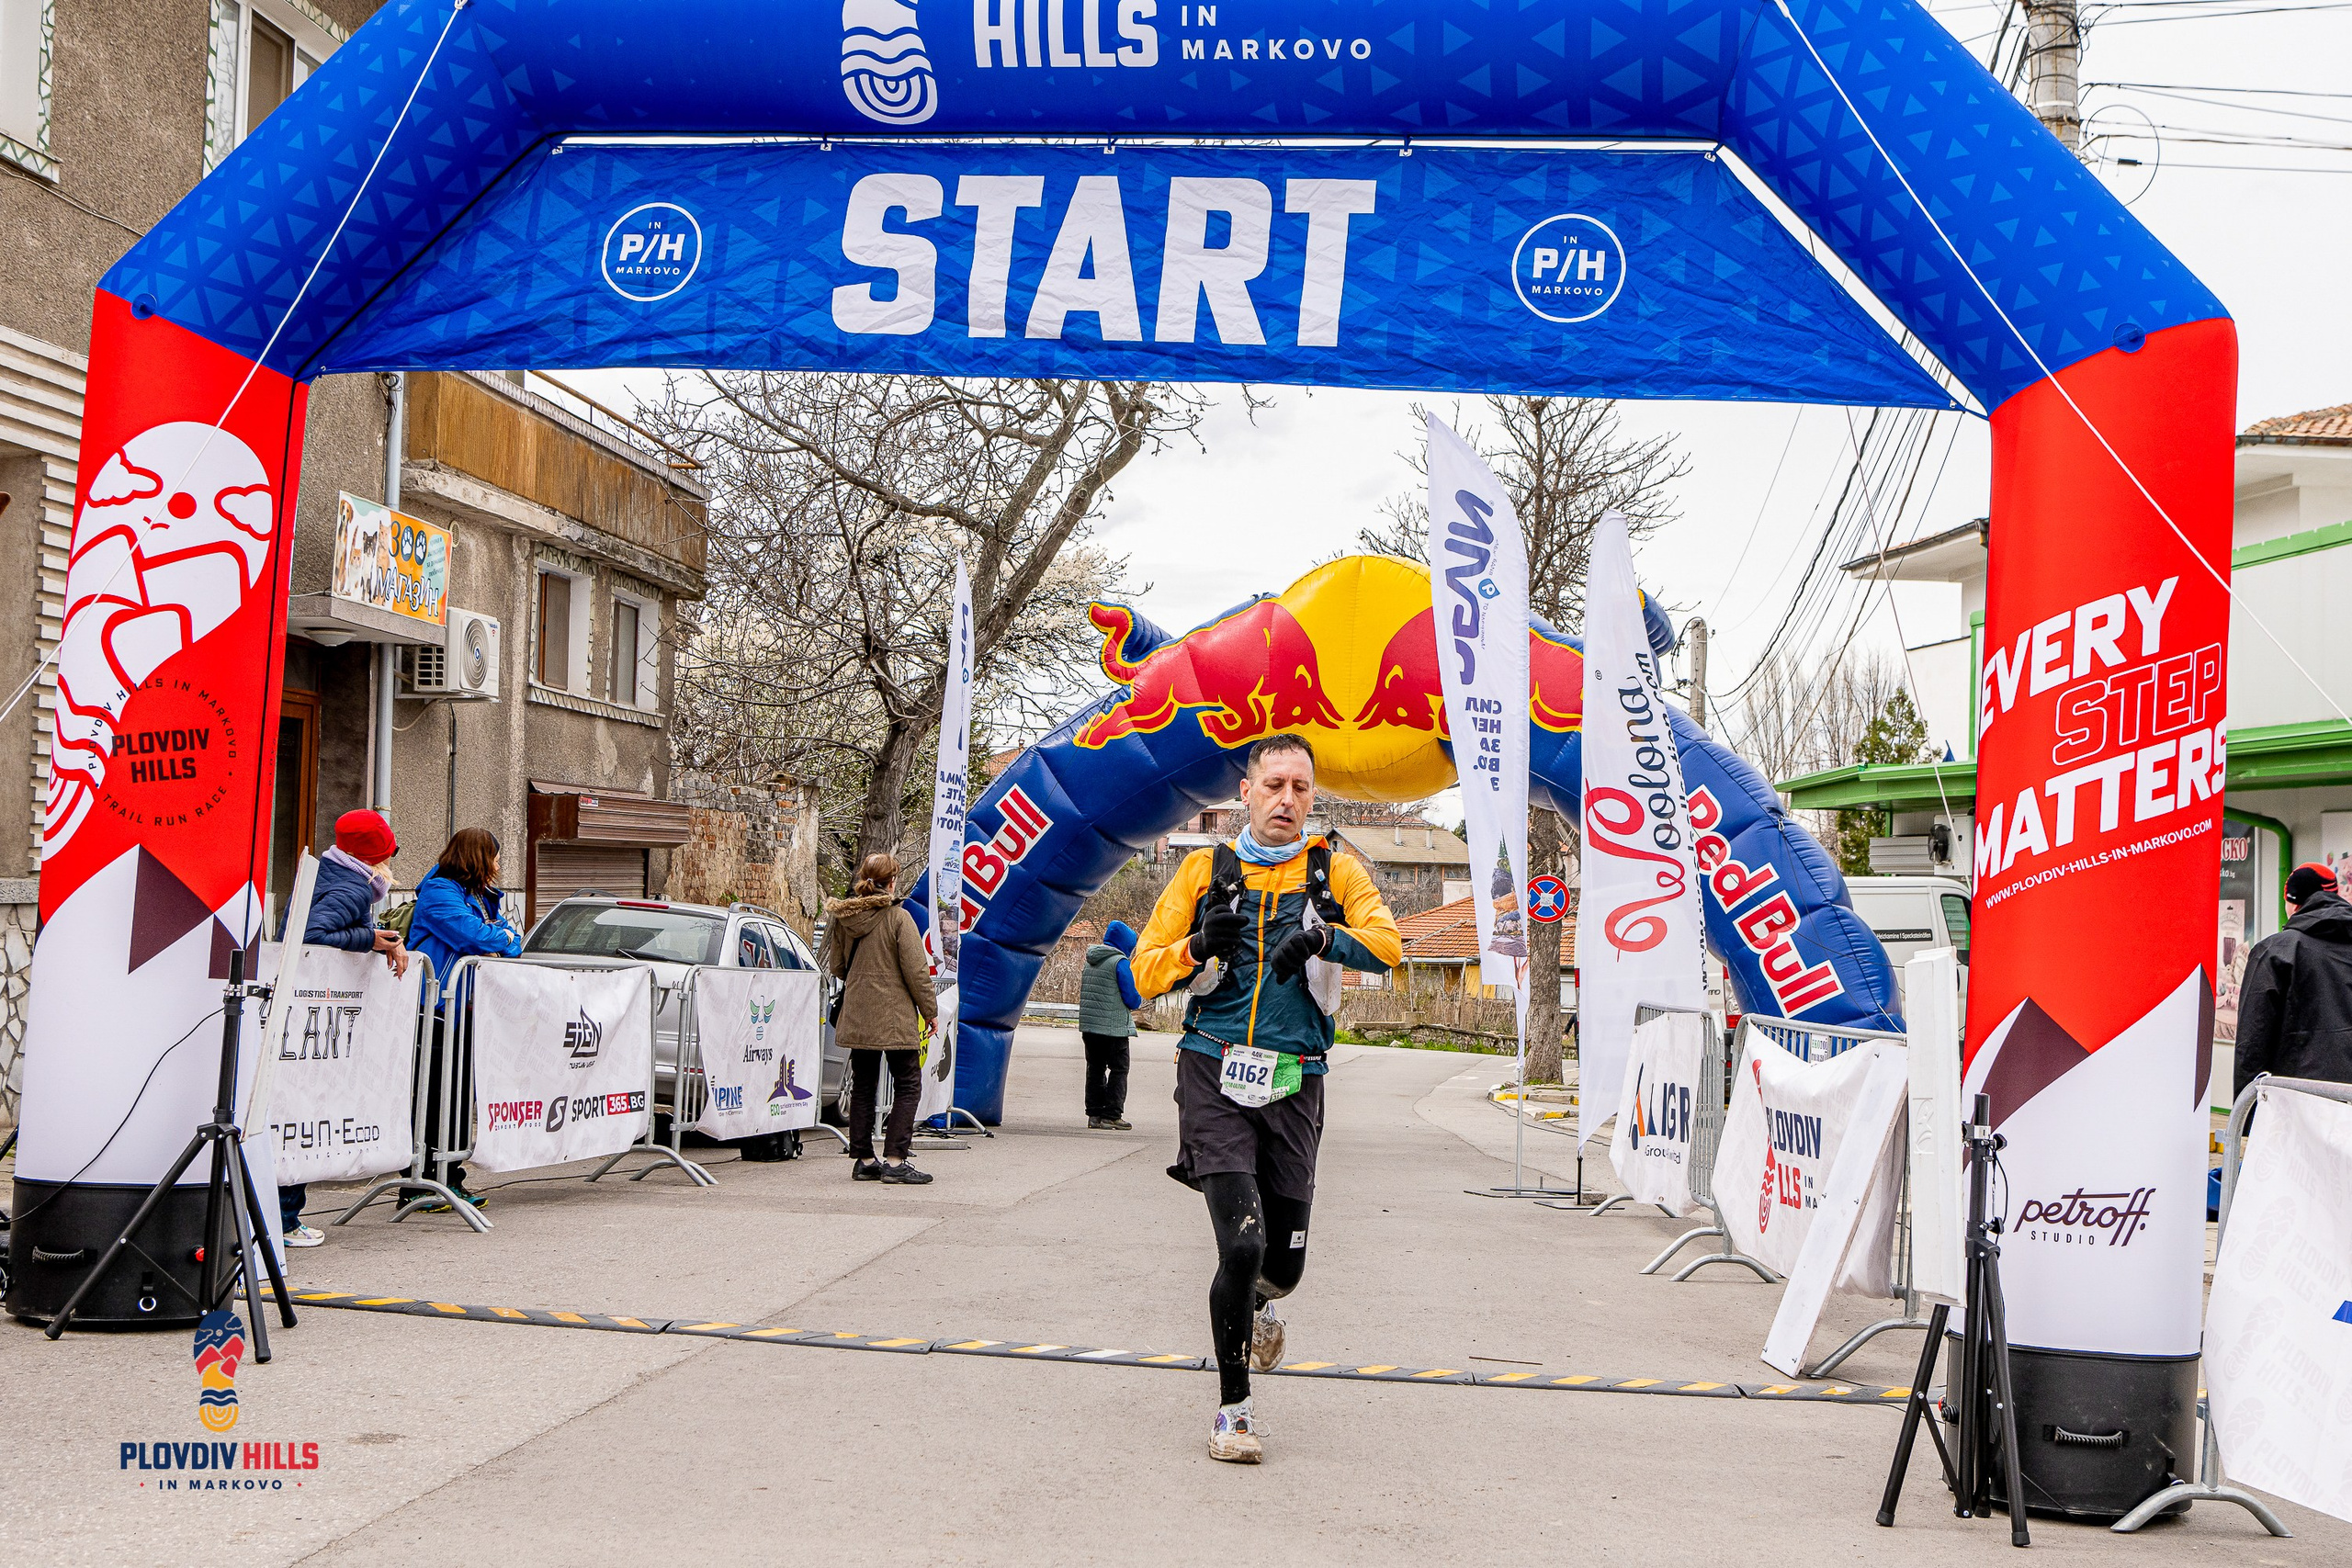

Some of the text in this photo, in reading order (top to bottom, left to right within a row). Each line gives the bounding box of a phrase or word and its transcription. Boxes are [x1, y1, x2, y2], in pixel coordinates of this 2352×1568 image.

[1182, 6, 1216, 26] IN
[974, 0, 1159, 68] HILLS
[1182, 39, 1373, 60] MARKOVO
[648, 221, 662, 230] IN
[1564, 236, 1577, 244] IN
[619, 233, 685, 263] P/H
[831, 174, 1377, 346] START
[616, 266, 681, 276] MARKOVO
[1532, 247, 1606, 283] P/H
[1532, 286, 1603, 296] MARKOVO
[376, 566, 439, 616] МАГАЗИН
[1980, 576, 2179, 739] EVERY
[2052, 643, 2222, 766] STEP
[88, 678, 237, 770] PLOVDIV HILLS IN MARKOVO
[111, 728, 209, 757] PLOVDIV
[130, 757, 197, 784] HILLS
[103, 786, 227, 826] TRAIL RUN RACE
[1973, 716, 2227, 897] MATTERS
[963, 787, 1048, 896] Bull
[1985, 818, 2212, 909] WWW.PLOVDIV-HILLS-IN-MARKOVO.COM
[1736, 895, 1839, 1014] Bull
[294, 989, 326, 998] LOGISTICS
[330, 991, 364, 999] TRANSPORT
[743, 1044, 773, 1066] Airways
[1225, 1061, 1269, 1086] 4162
[488, 1100, 543, 1132] SPONSER
[770, 1103, 780, 1116] ECO
[1804, 1175, 1814, 1190] IN
[2030, 1230, 2096, 1246] STUDIO
